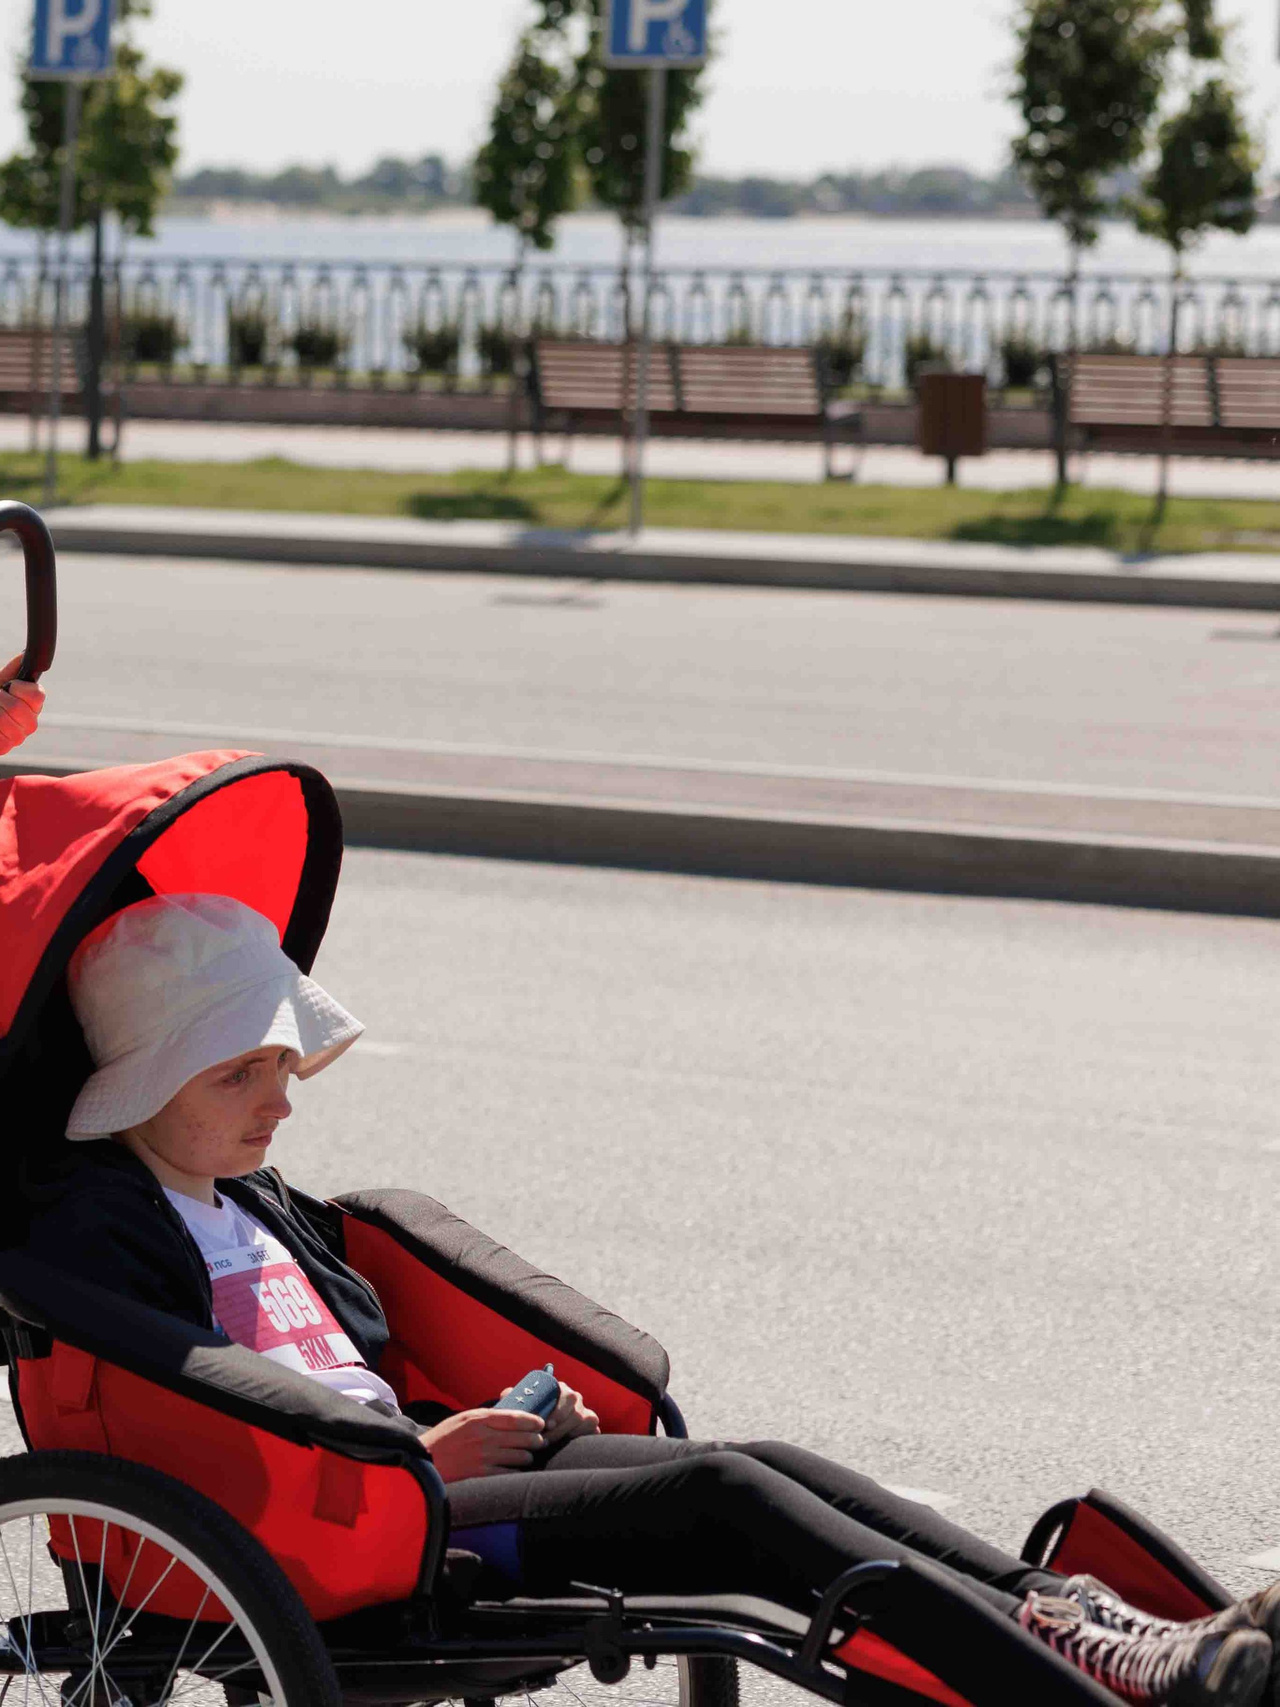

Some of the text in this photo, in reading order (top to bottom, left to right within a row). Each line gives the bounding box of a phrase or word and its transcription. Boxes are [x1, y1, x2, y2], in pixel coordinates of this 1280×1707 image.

[48, 0, 100, 62] P
[214, 1259, 232, 1270] ПСБ
[250, 1276, 322, 1333] 569
